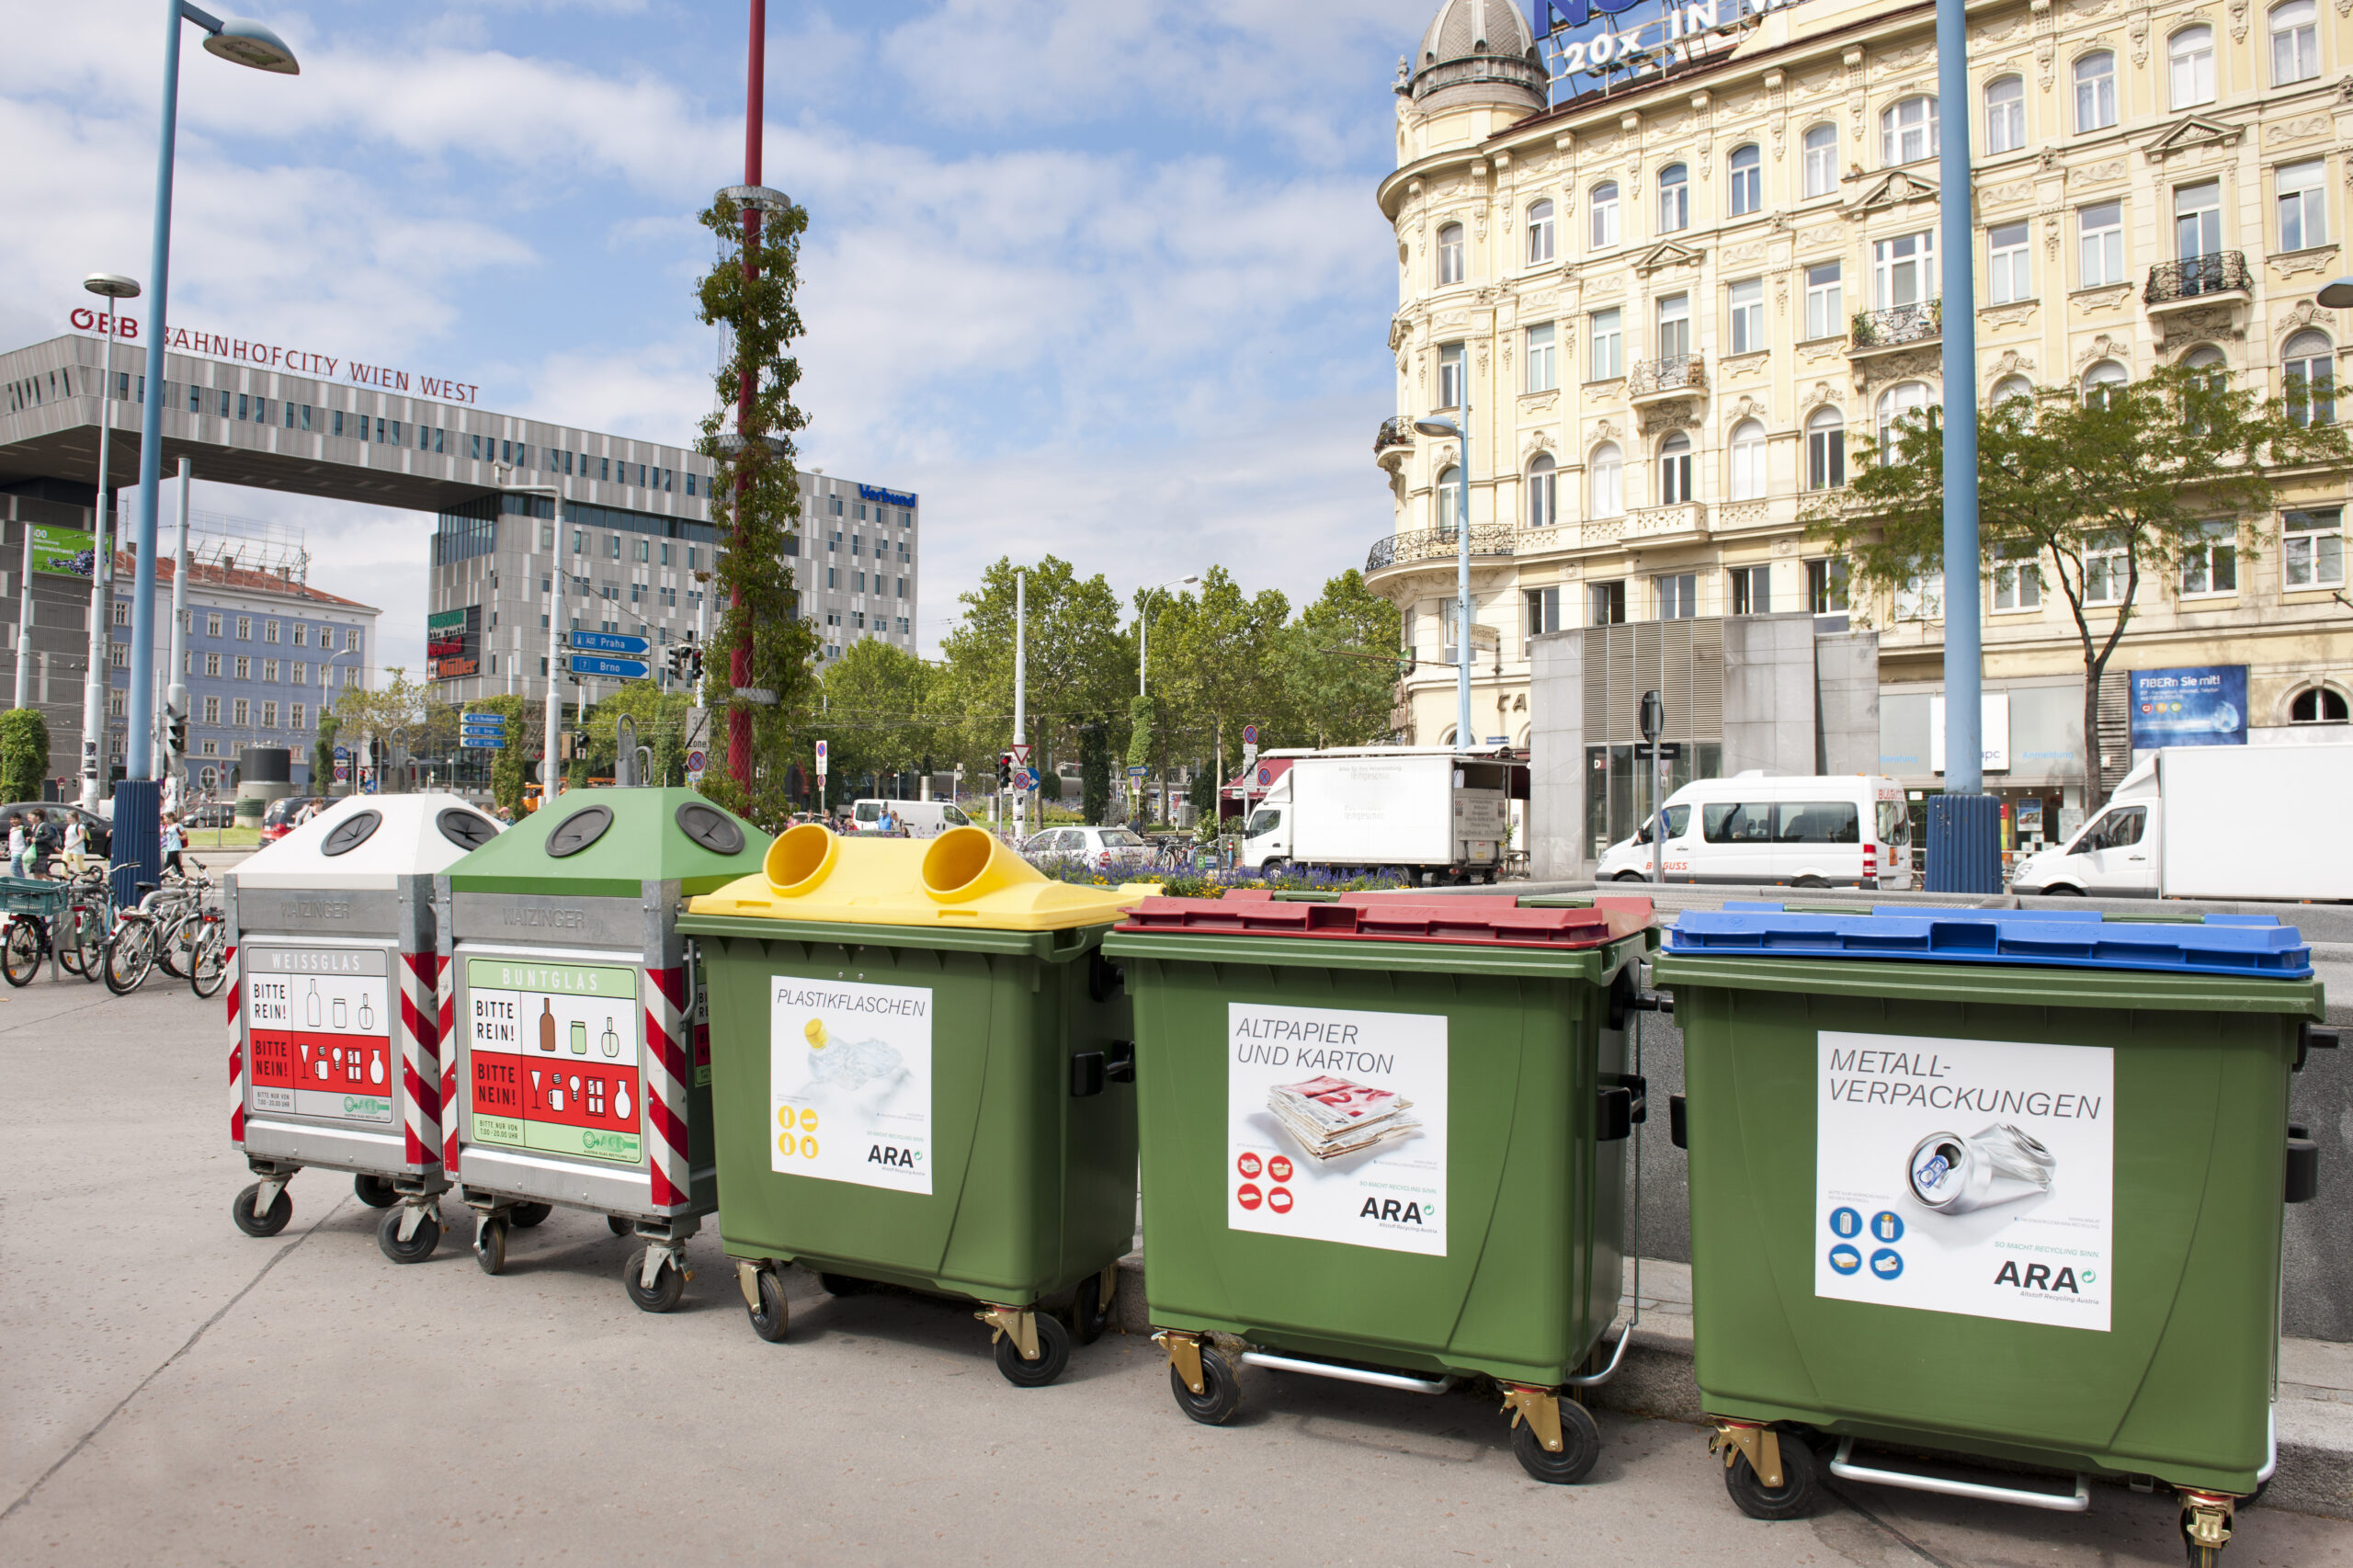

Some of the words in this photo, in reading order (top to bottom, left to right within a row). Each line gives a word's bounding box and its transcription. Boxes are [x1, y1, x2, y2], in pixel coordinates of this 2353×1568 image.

[1563, 30, 1643, 75] 20x
[1671, 0, 1719, 40] IN
[70, 307, 139, 339] ÖBB
[350, 360, 409, 392] WIEN
[421, 375, 479, 403] WEST
[858, 483, 915, 507] Verbund
[601, 637, 625, 648] Praha
[438, 657, 476, 677] Müller
[600, 661, 620, 672] Brno
[2140, 677, 2178, 688] FIBERn
[2181, 676, 2198, 687] Sie
[2200, 675, 2221, 685] mit!
[2022, 750, 2074, 761] Anmeldung
[1645, 861, 1688, 870] BGUSS
[279, 901, 350, 920] WAIZINGER
[503, 907, 585, 929] WAIZINGER
[272, 953, 360, 971] WEISSGLAS
[502, 968, 598, 991] BUNTGLAS
[254, 983, 285, 999] BITTE
[255, 1004, 286, 1019] REIN!
[476, 1000, 514, 1019] BITTE
[777, 988, 926, 1017] PLASTIKFLASCHEN
[477, 1022, 514, 1041] REIN!
[1236, 1017, 1358, 1045] ALTPAPIER
[256, 1040, 287, 1057] BITTE
[1238, 1043, 1289, 1066] UND
[1296, 1048, 1394, 1074] KARTON
[1830, 1048, 1951, 1078] METALL-
[256, 1060, 288, 1077] NEIN!
[477, 1063, 516, 1084] BITTE
[257, 1091, 268, 1099] BITTE
[270, 1092, 279, 1100] NUR
[478, 1085, 516, 1106] NEIN!
[1830, 1078, 2101, 1119] VERPACKUNGEN
[480, 1119, 494, 1129] BITTE
[495, 1121, 506, 1130] NUR
[507, 1122, 518, 1131] VON
[508, 1131, 518, 1140] UHR
[868, 1144, 914, 1168] ARA
[1369, 1181, 1388, 1189] MACHT
[1389, 1184, 1421, 1193] RECYCLING
[1359, 1197, 1423, 1225] ARA
[1397, 1224, 1420, 1233] Recycling
[2006, 1242, 2034, 1251] MACHT
[2034, 1244, 2078, 1256] RECYCLING
[1994, 1260, 2079, 1294] ARA
[2019, 1290, 2043, 1299] Altstoff
[2043, 1292, 2075, 1303] Recycling
[2076, 1296, 2099, 1305] Austria
